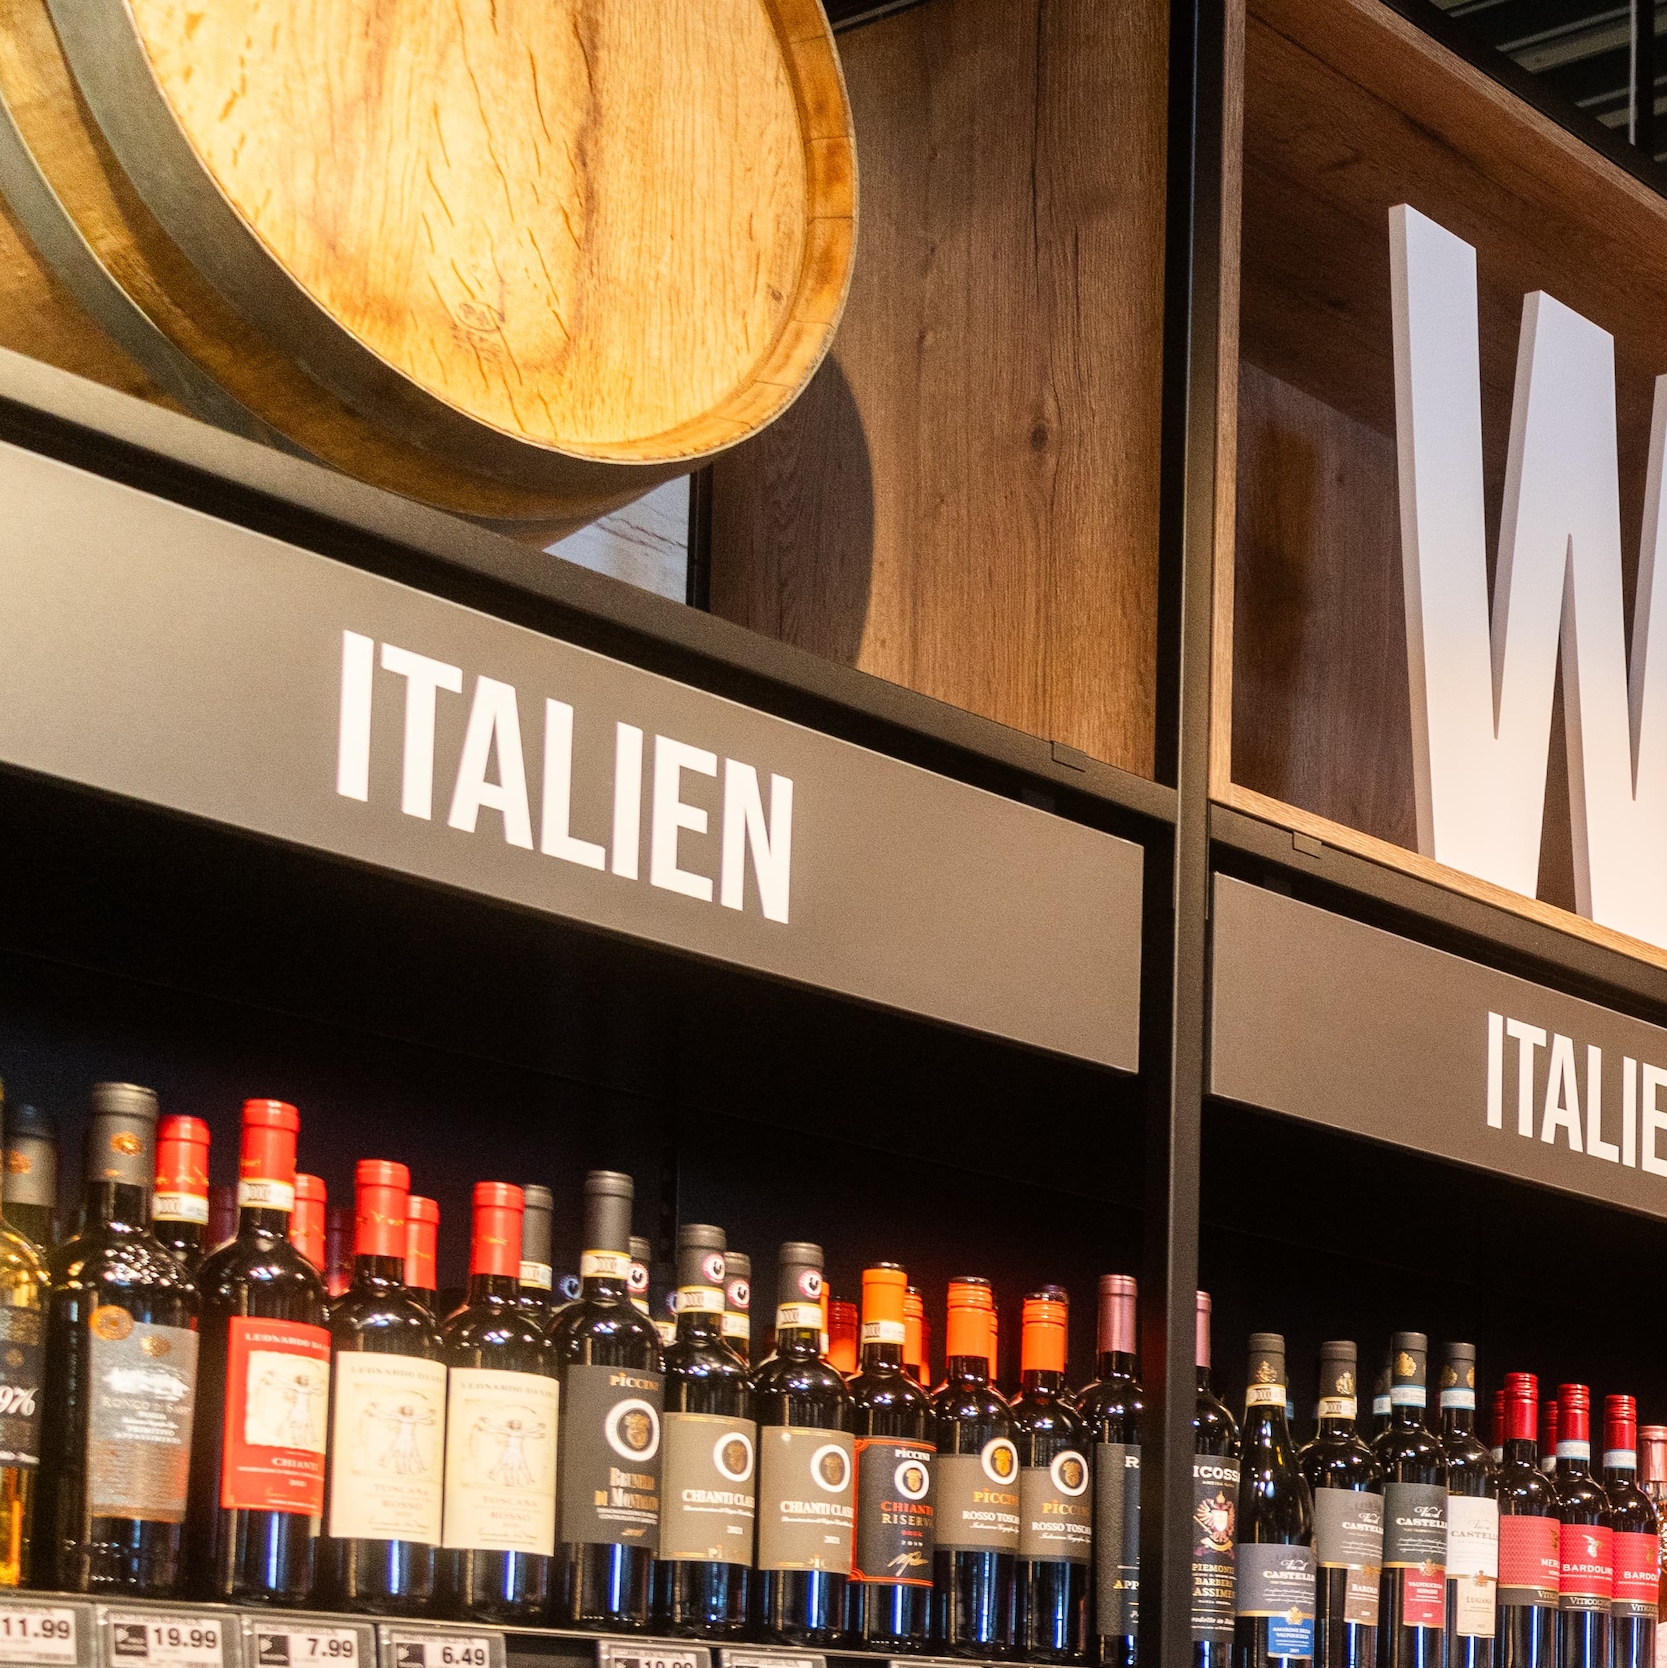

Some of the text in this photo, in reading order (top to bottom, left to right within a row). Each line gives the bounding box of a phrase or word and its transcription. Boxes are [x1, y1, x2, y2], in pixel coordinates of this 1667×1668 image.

[336, 629, 793, 925] ITALIEN
[682, 1489, 731, 1505] CHIANTI
[153, 1627, 217, 1649] 19.99
[307, 1637, 353, 1658] 7.99
[442, 1646, 486, 1666] 6.49
